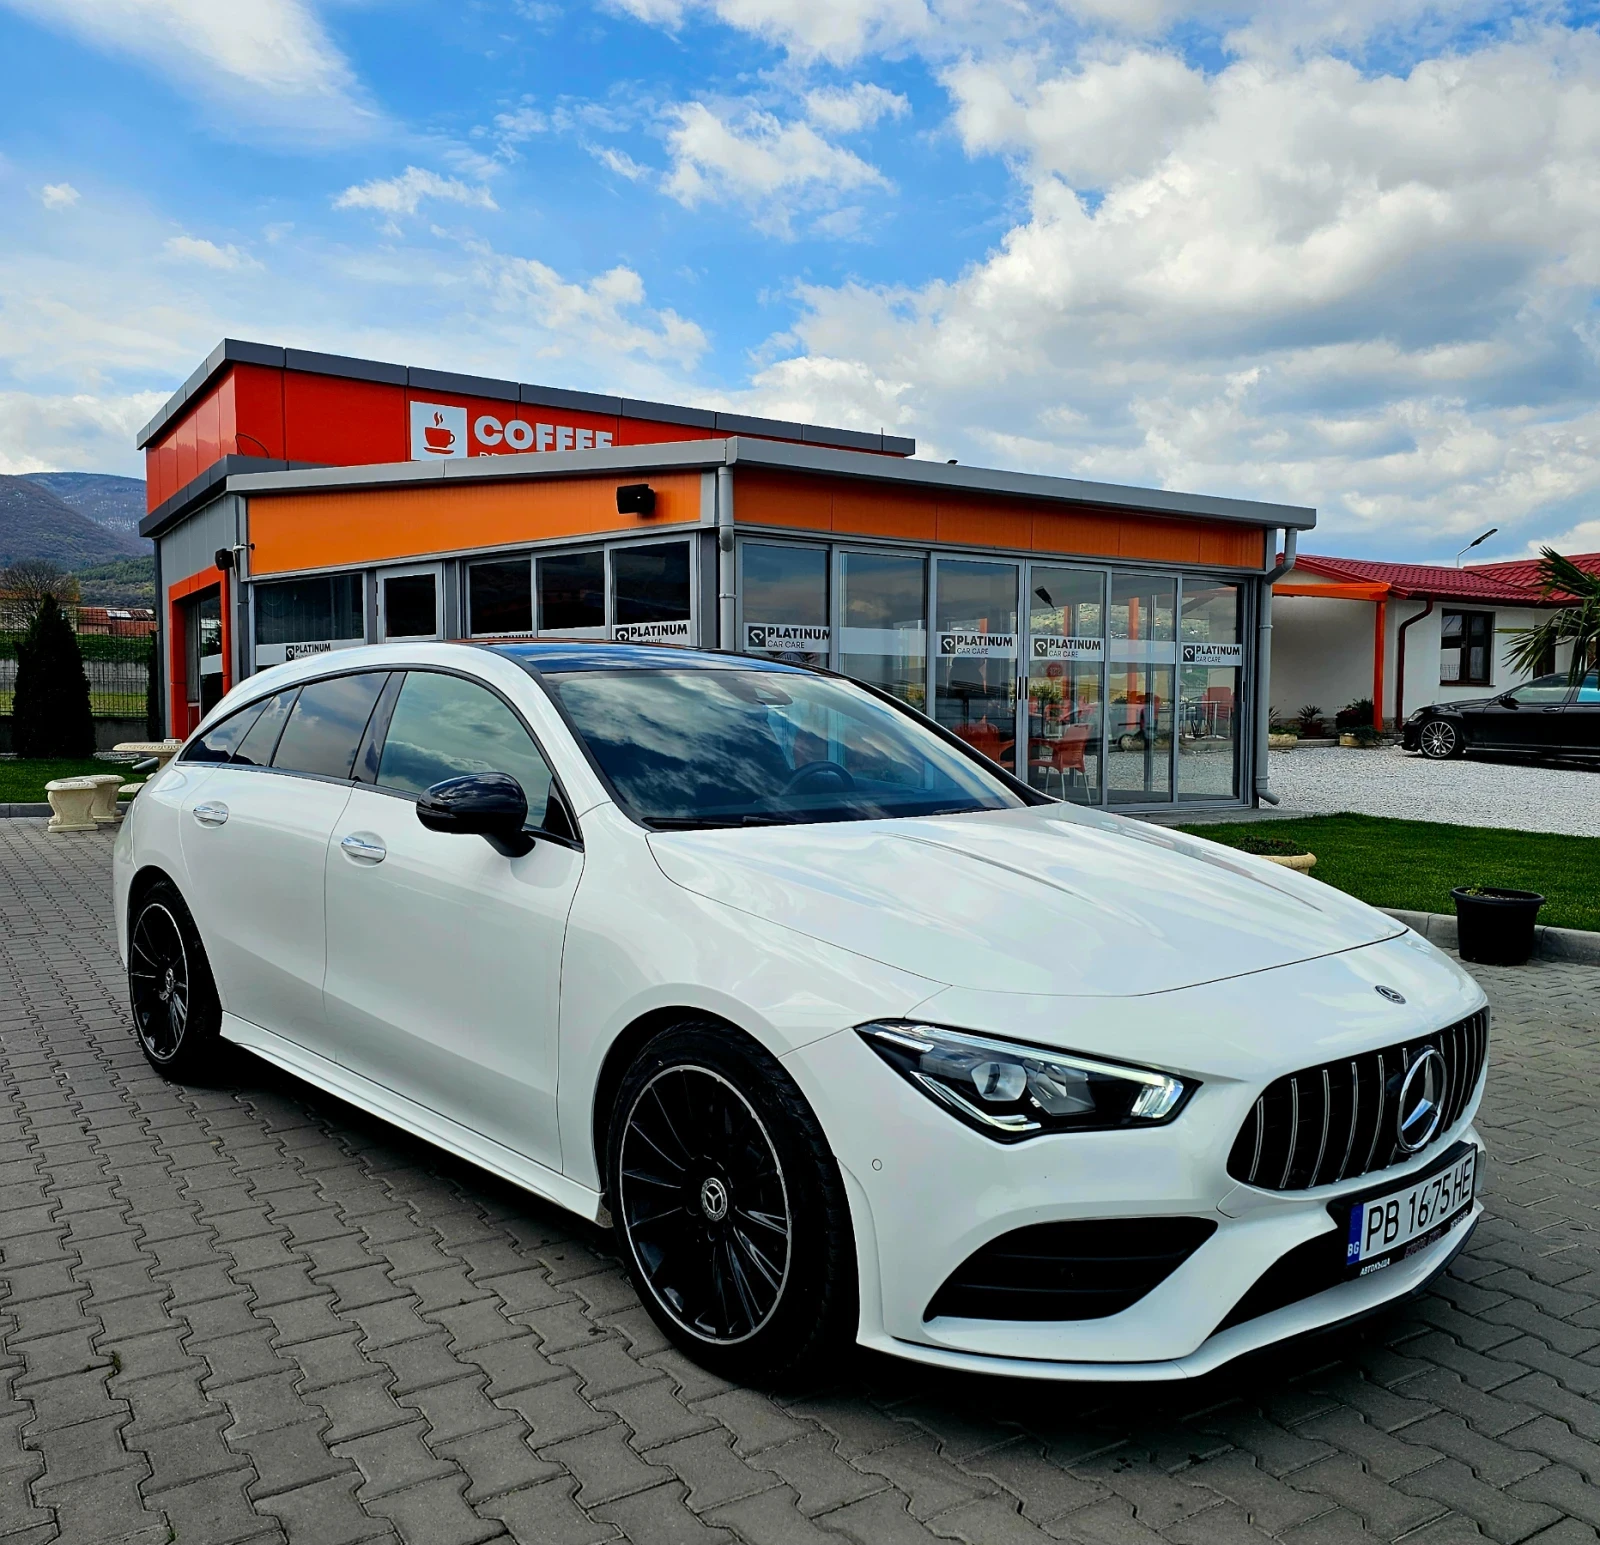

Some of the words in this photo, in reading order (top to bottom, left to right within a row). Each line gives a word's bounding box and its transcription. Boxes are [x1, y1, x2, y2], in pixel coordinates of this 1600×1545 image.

[630, 623, 688, 638] PLATINUM
[767, 640, 783, 648] CAR
[785, 641, 805, 649] CARE
[956, 635, 1013, 647] PLATINUM
[1049, 638, 1101, 650] PLATINUM
[295, 642, 331, 654] PLATINUM
[1195, 645, 1240, 656] PLATINUM
[1365, 1199, 1400, 1252] PB
[1408, 1172, 1452, 1234] 1675
[1451, 1156, 1473, 1208] HE
[1347, 1241, 1360, 1257] BG
